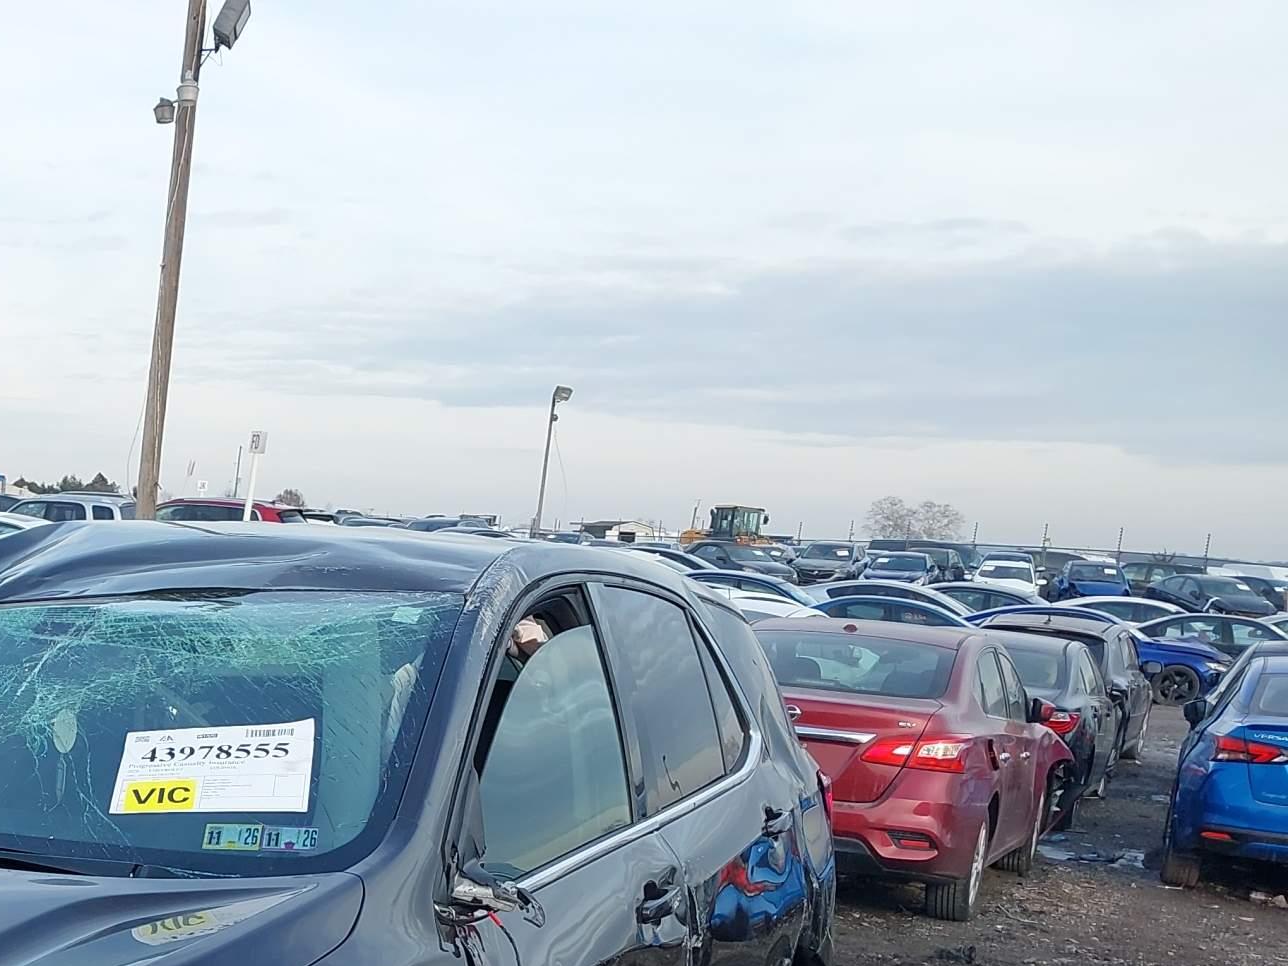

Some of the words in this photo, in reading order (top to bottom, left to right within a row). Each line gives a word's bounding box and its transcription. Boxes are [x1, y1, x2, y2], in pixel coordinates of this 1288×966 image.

[140, 742, 291, 763] 43978555
[132, 786, 191, 805] VIC
[244, 827, 260, 846] 26
[302, 829, 319, 848] 26
